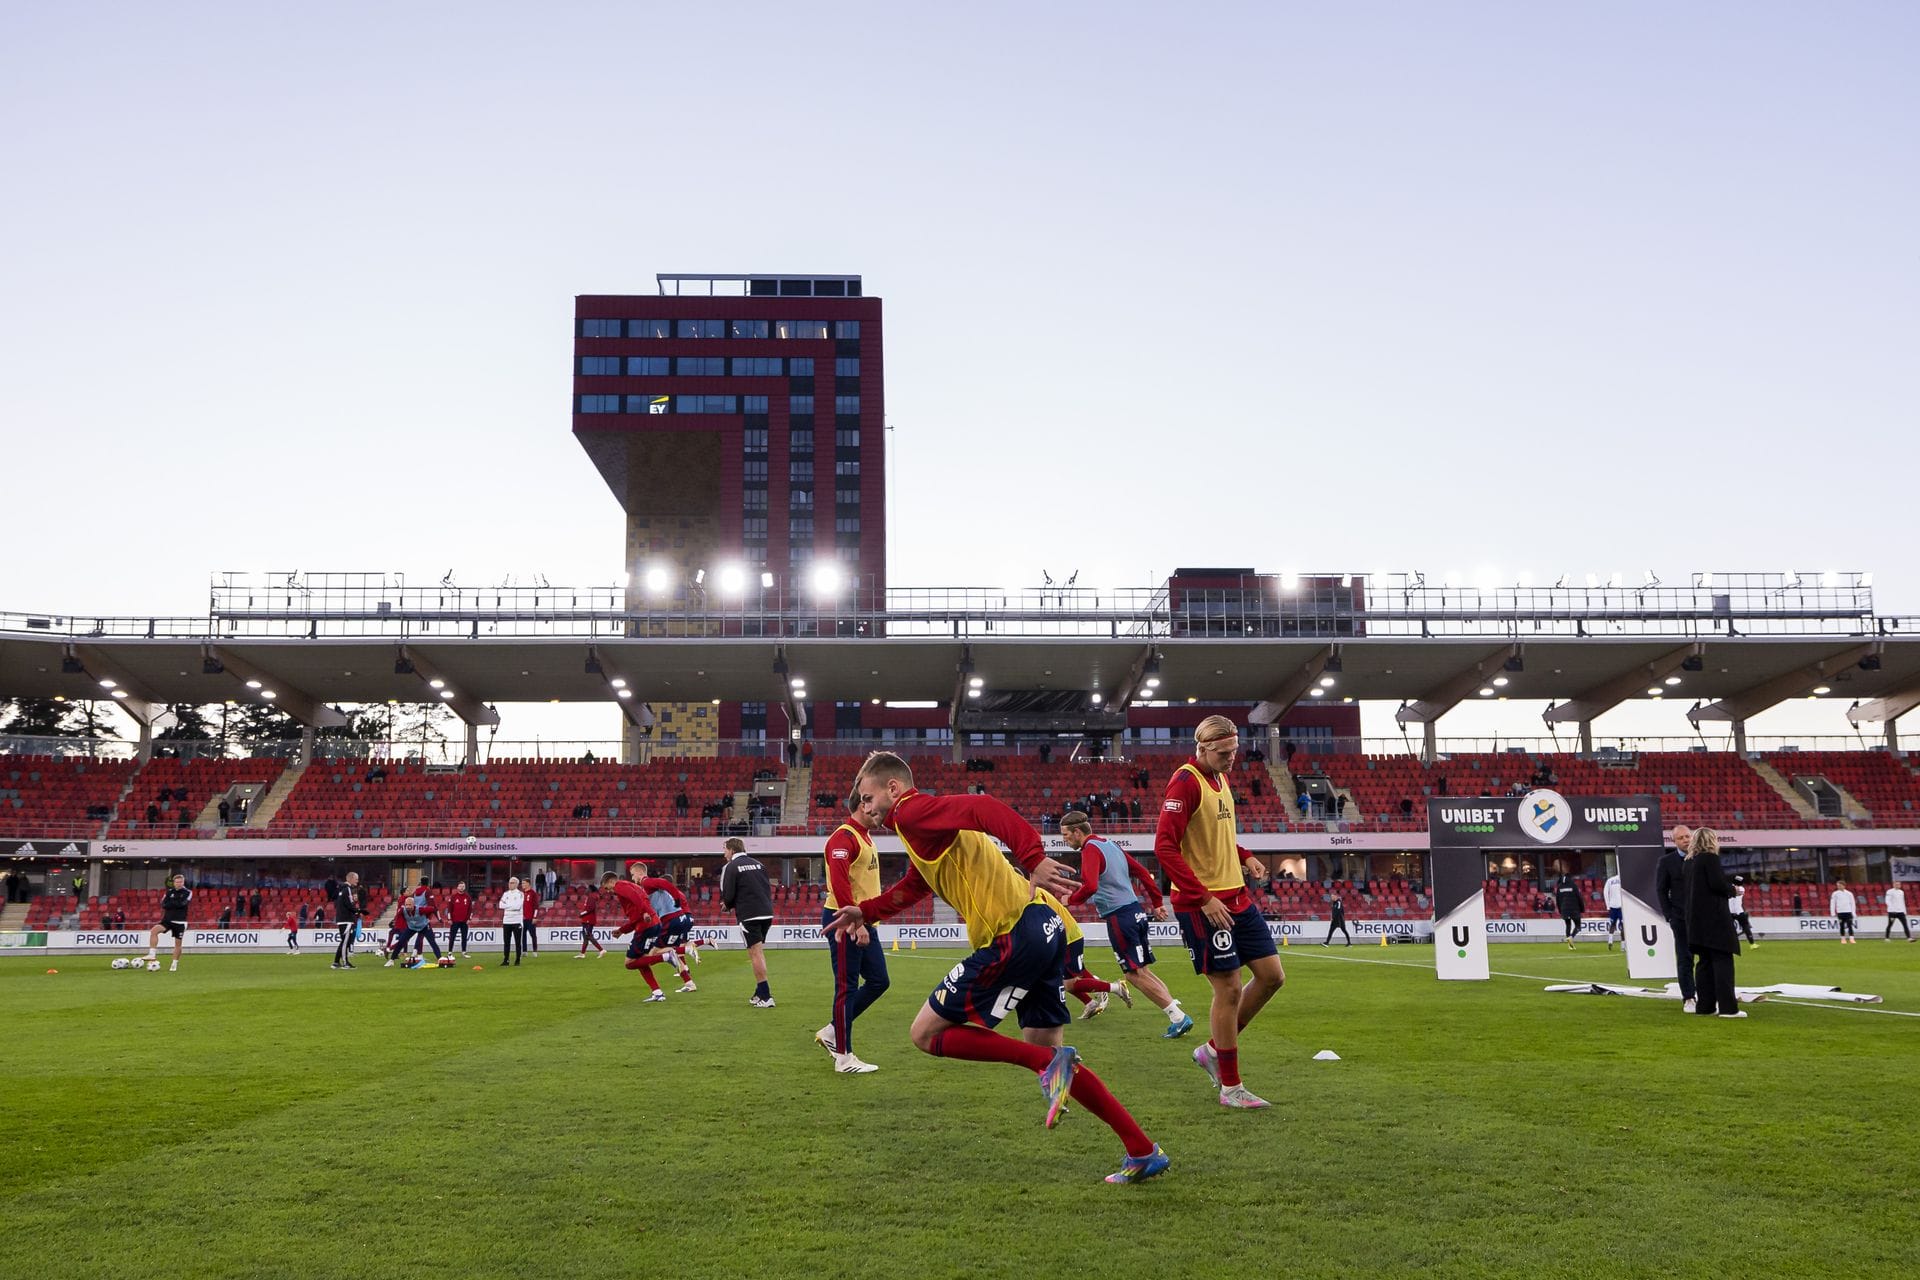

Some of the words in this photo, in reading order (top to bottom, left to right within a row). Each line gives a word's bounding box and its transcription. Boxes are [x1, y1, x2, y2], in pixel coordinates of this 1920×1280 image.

[650, 405, 666, 414] EY
[1441, 808, 1505, 823] UNIBET
[1584, 807, 1649, 822] UNIBET
[1330, 836, 1353, 845] Spiris
[102, 844, 126, 854] Spiris
[346, 843, 385, 851] Smartare
[387, 842, 432, 853] bokföring.
[479, 842, 518, 851] business.
[1269, 924, 1301, 935] MON
[1355, 923, 1414, 934] PREMON
[1485, 922, 1526, 933] EMON
[1800, 919, 1858, 929] PREMN
[314, 932, 378, 943] PREON
[550, 930, 612, 941] PREON
[687, 929, 728, 940] EMON
[899, 927, 960, 938] PREMON
[1452, 925, 1469, 947] U
[1641, 924, 1658, 946] U
[76, 934, 140, 945] PREMON
[195, 933, 259, 944] PREMON
